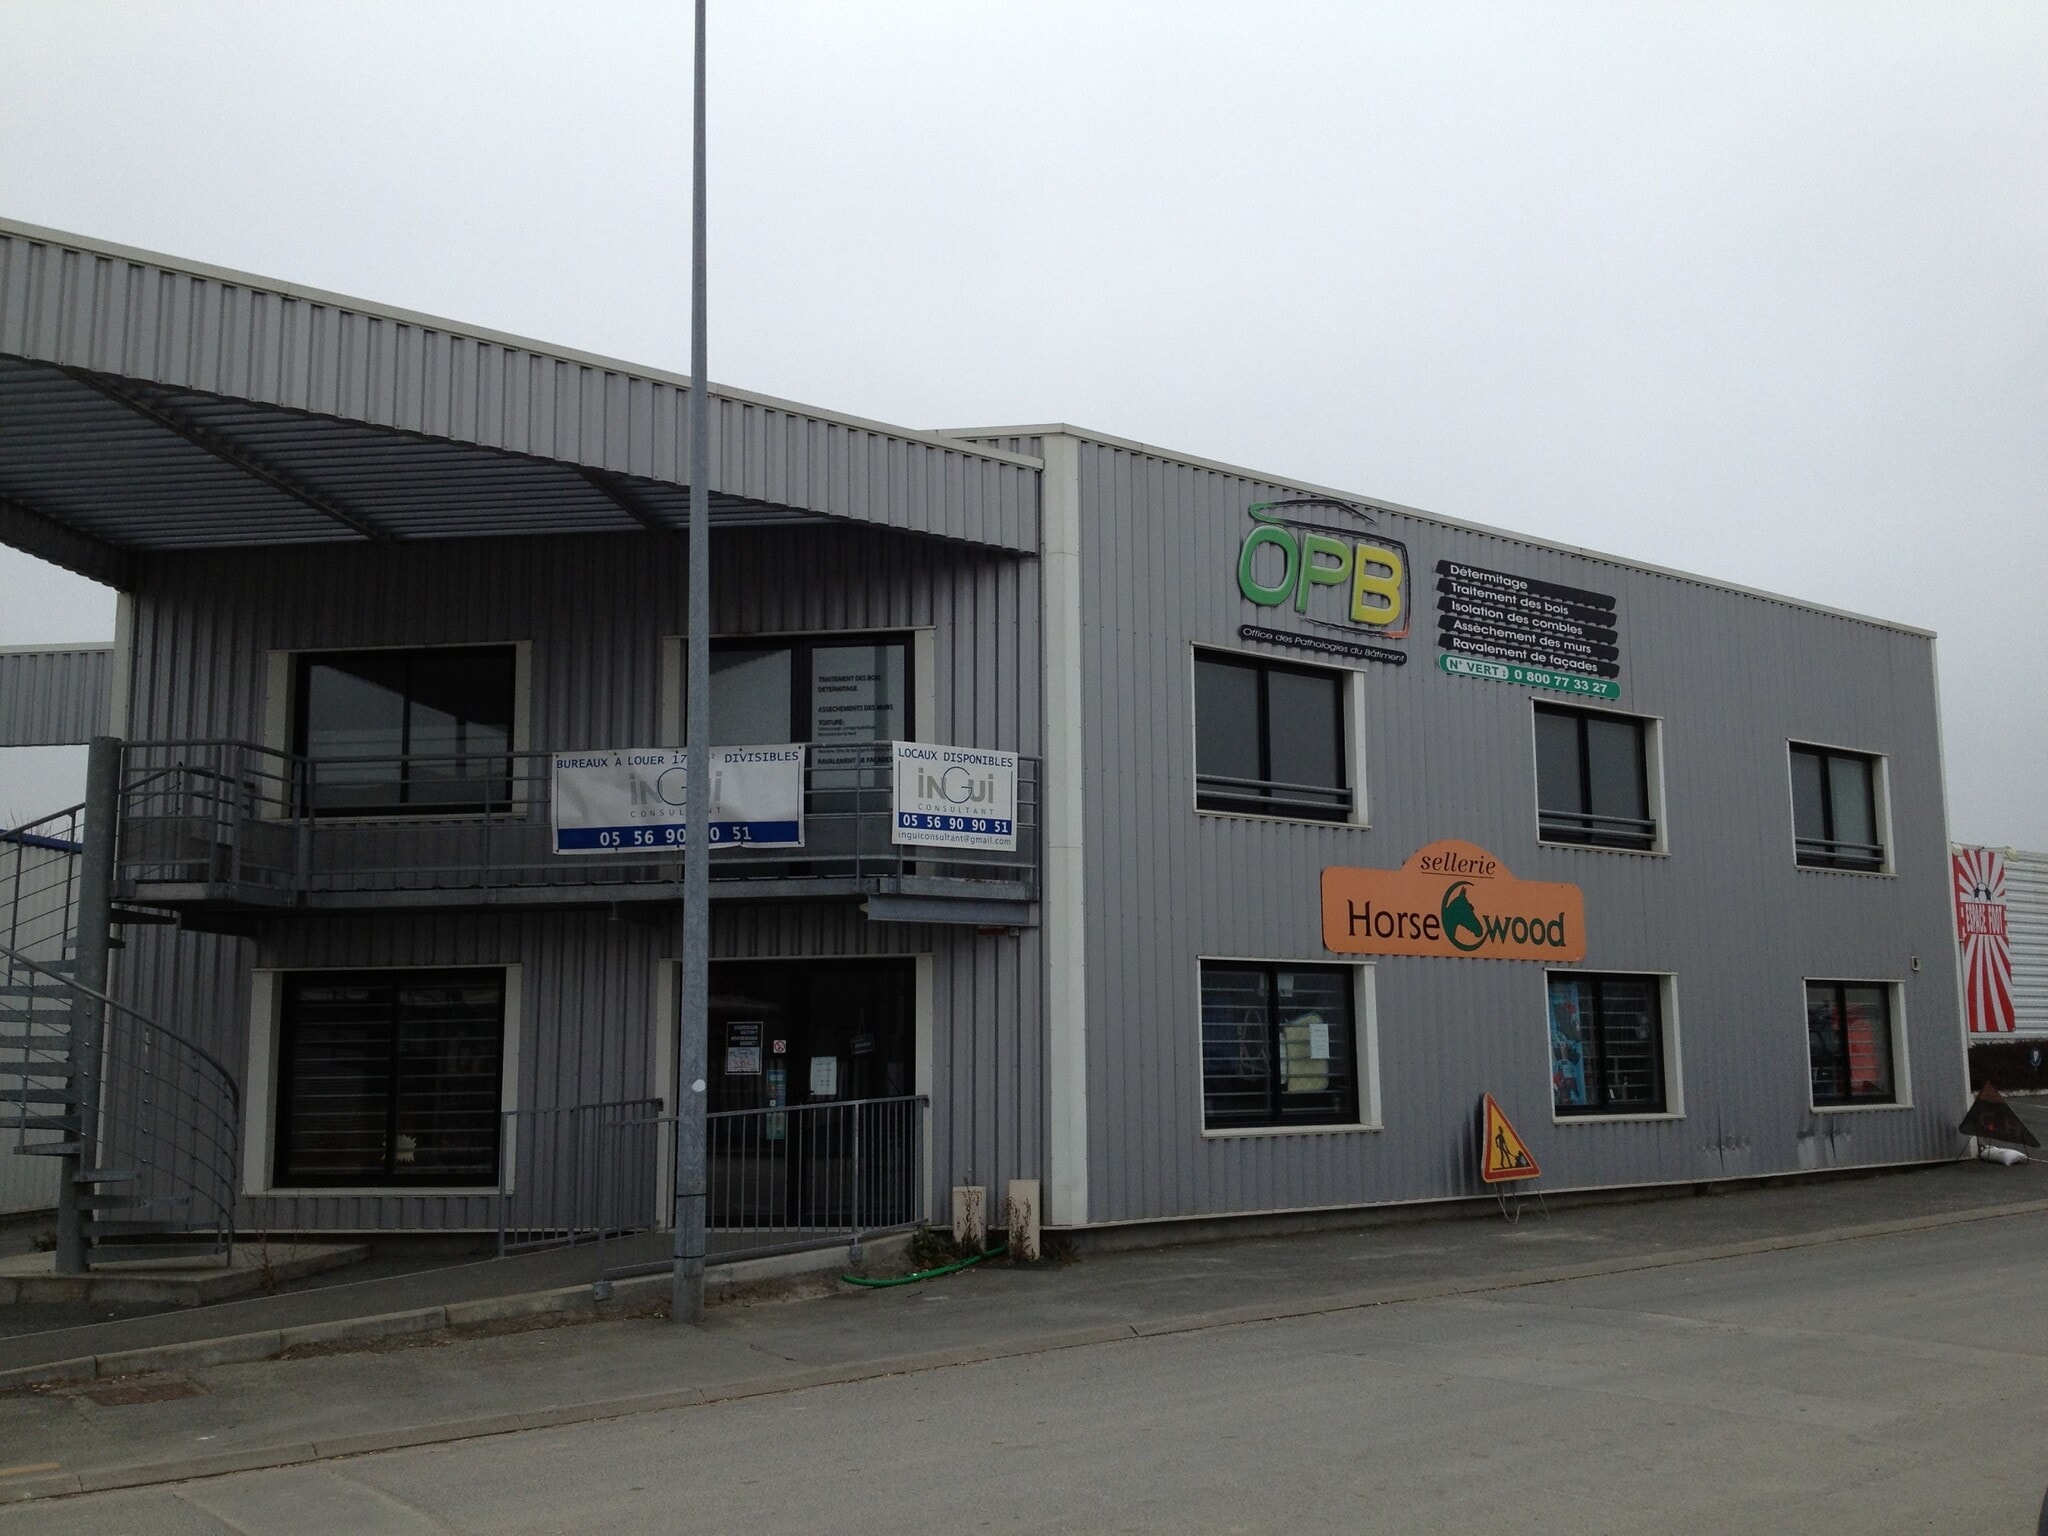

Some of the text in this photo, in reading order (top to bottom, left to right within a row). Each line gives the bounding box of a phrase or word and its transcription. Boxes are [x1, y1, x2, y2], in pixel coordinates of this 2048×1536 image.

[1238, 525, 1402, 625] OPB
[1450, 564, 1528, 590] Détermitage
[1451, 582, 1569, 615] Traitement des bois
[1451, 601, 1583, 635] Isolation des combles
[1242, 627, 1405, 662] Office des Pathologies du Bâtiment
[1453, 620, 1592, 654] Assèchement des murs
[1453, 638, 1598, 672] Ravalement de façades
[1466, 662, 1499, 676] VERT
[1514, 670, 1523, 680] 0
[1526, 672, 1550, 684] 800
[1554, 676, 1570, 687] 77
[1573, 679, 1589, 691] 33
[1592, 682, 1608, 693] 27
[556, 758, 608, 768] BUREAUX
[628, 756, 665, 766] LOUER
[724, 751, 799, 763] DIVISIBLES
[898, 747, 938, 760] LOCAUX
[943, 752, 1013, 768] DISPONIBLES
[918, 803, 994, 815] CONSULTANT
[600, 831, 620, 846] 05
[634, 830, 654, 845] 56
[666, 828, 686, 843] 90
[733, 826, 752, 840] 51
[903, 814, 1008, 833] 05 56 90 90 51
[898, 830, 1011, 846] inguiconsultant@gmail.com
[1420, 852, 1496, 876] sellerie
[1347, 899, 1566, 947] Horse wood
